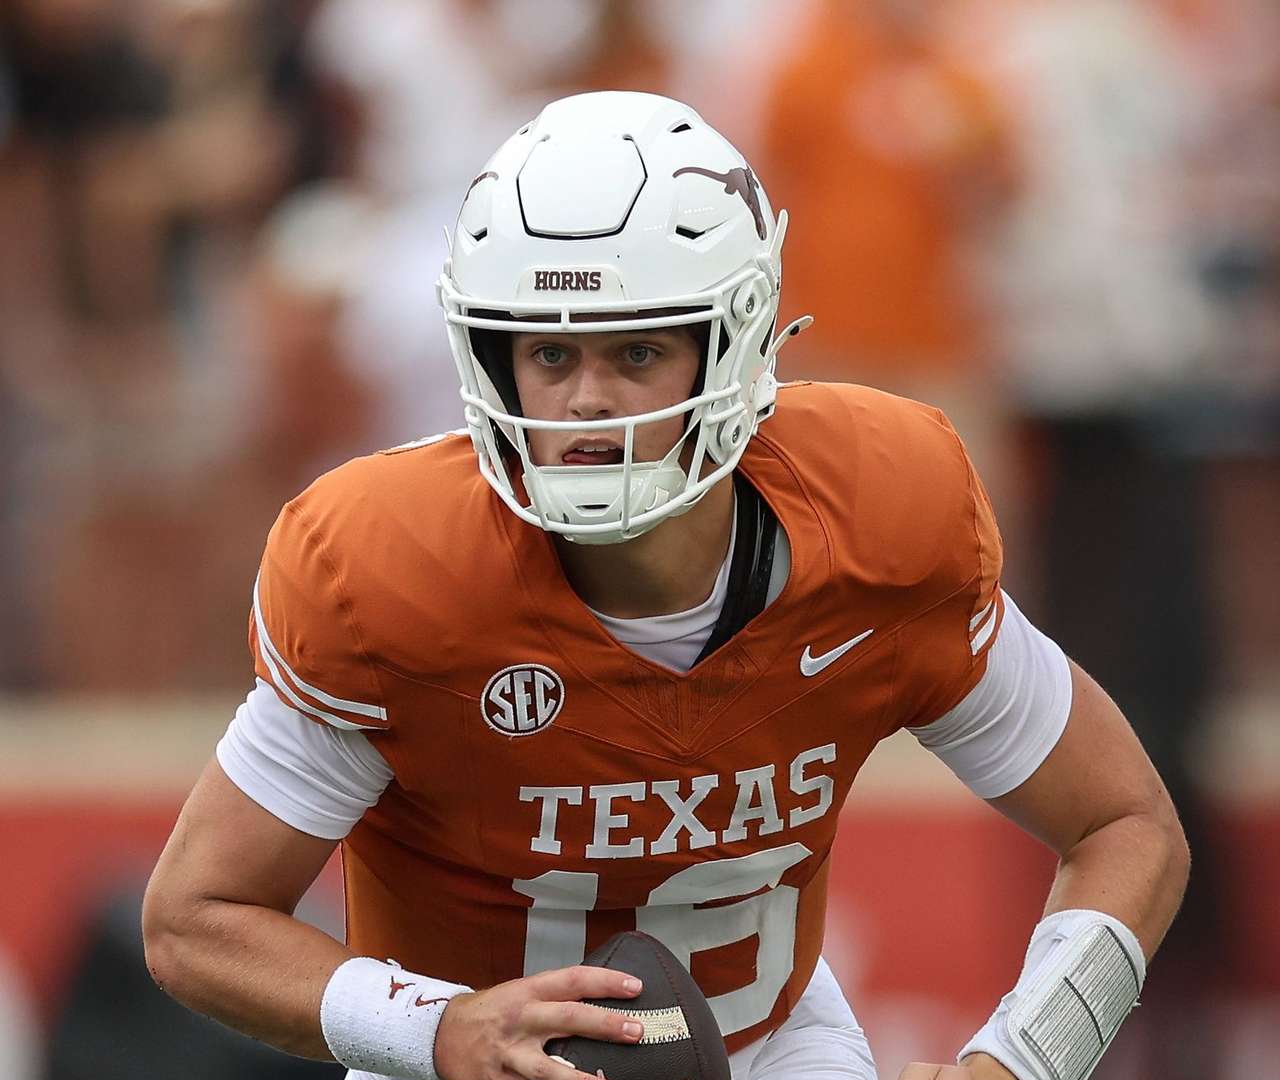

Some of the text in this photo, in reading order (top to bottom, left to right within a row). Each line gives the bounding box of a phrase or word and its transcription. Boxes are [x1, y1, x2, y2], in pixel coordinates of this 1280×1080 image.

[534, 271, 602, 291] HORNS
[488, 669, 557, 731] SEC
[519, 742, 837, 859] TEXAS
[512, 842, 813, 1037] 16
